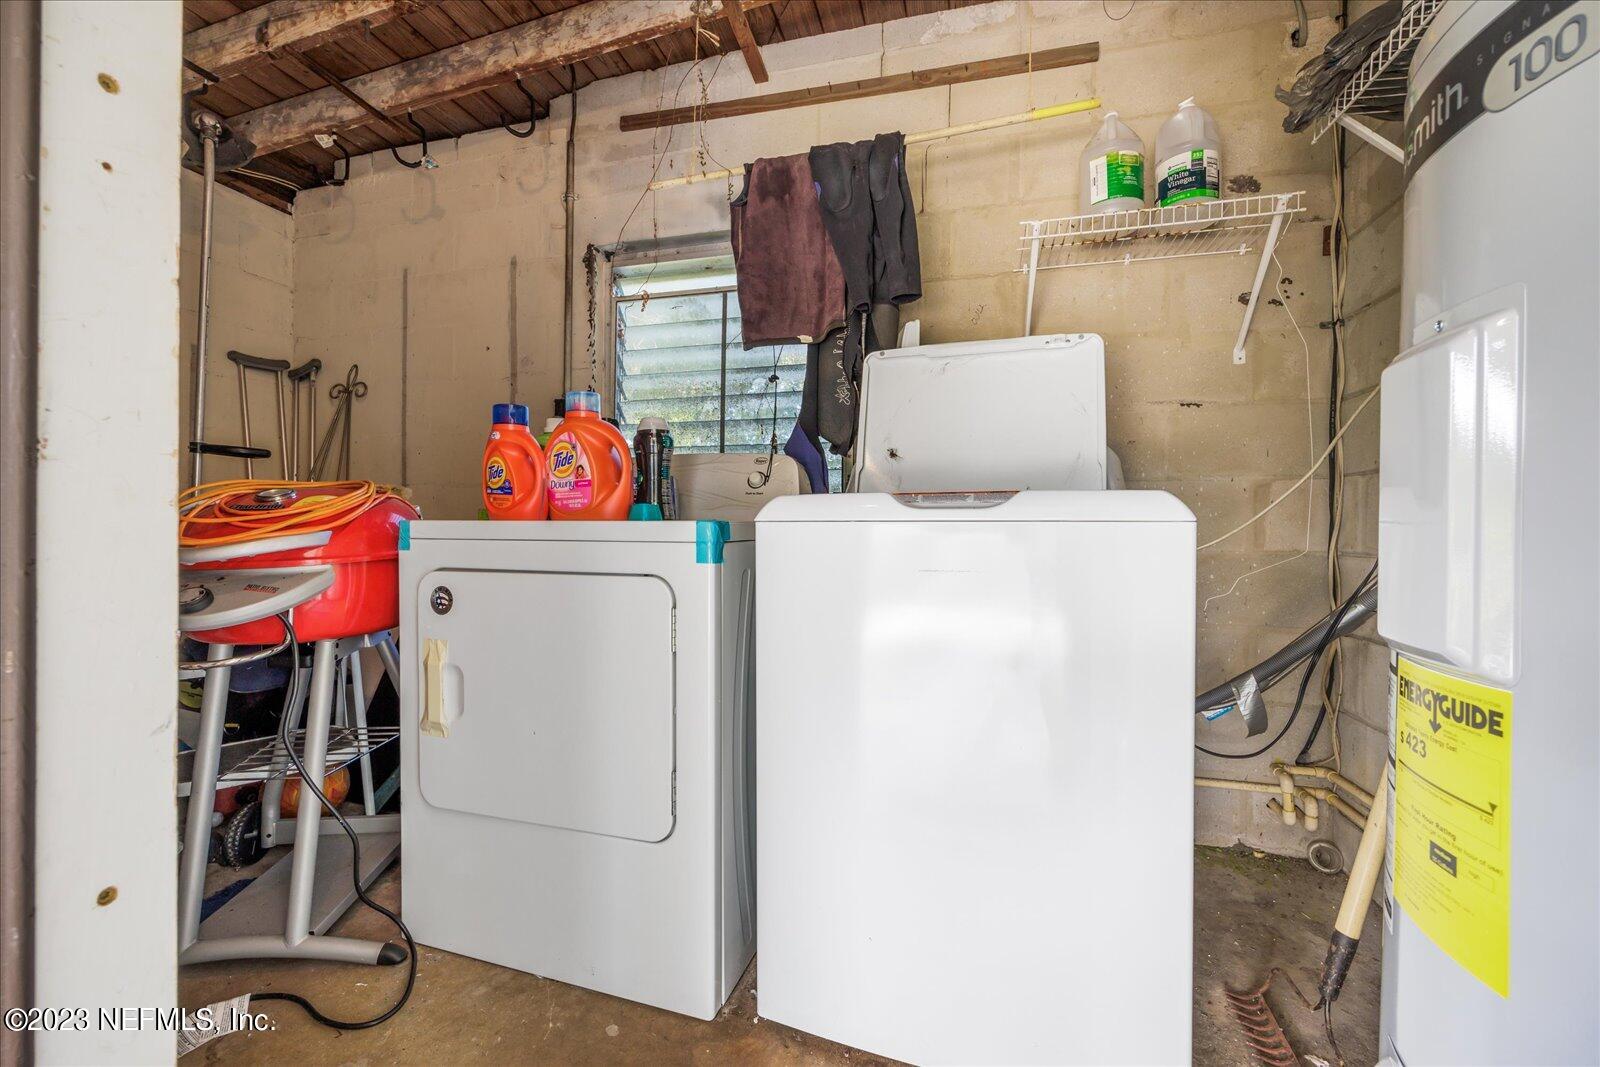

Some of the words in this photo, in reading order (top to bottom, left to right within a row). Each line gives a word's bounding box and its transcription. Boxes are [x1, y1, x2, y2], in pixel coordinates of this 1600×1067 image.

[1508, 13, 1587, 92] 100
[1167, 175, 1197, 189] Vinegar
[1168, 171, 1189, 183] White
[553, 450, 574, 472] Tide
[488, 464, 504, 482] Tide
[551, 480, 575, 490] Downy
[1406, 732, 1427, 758] 423
